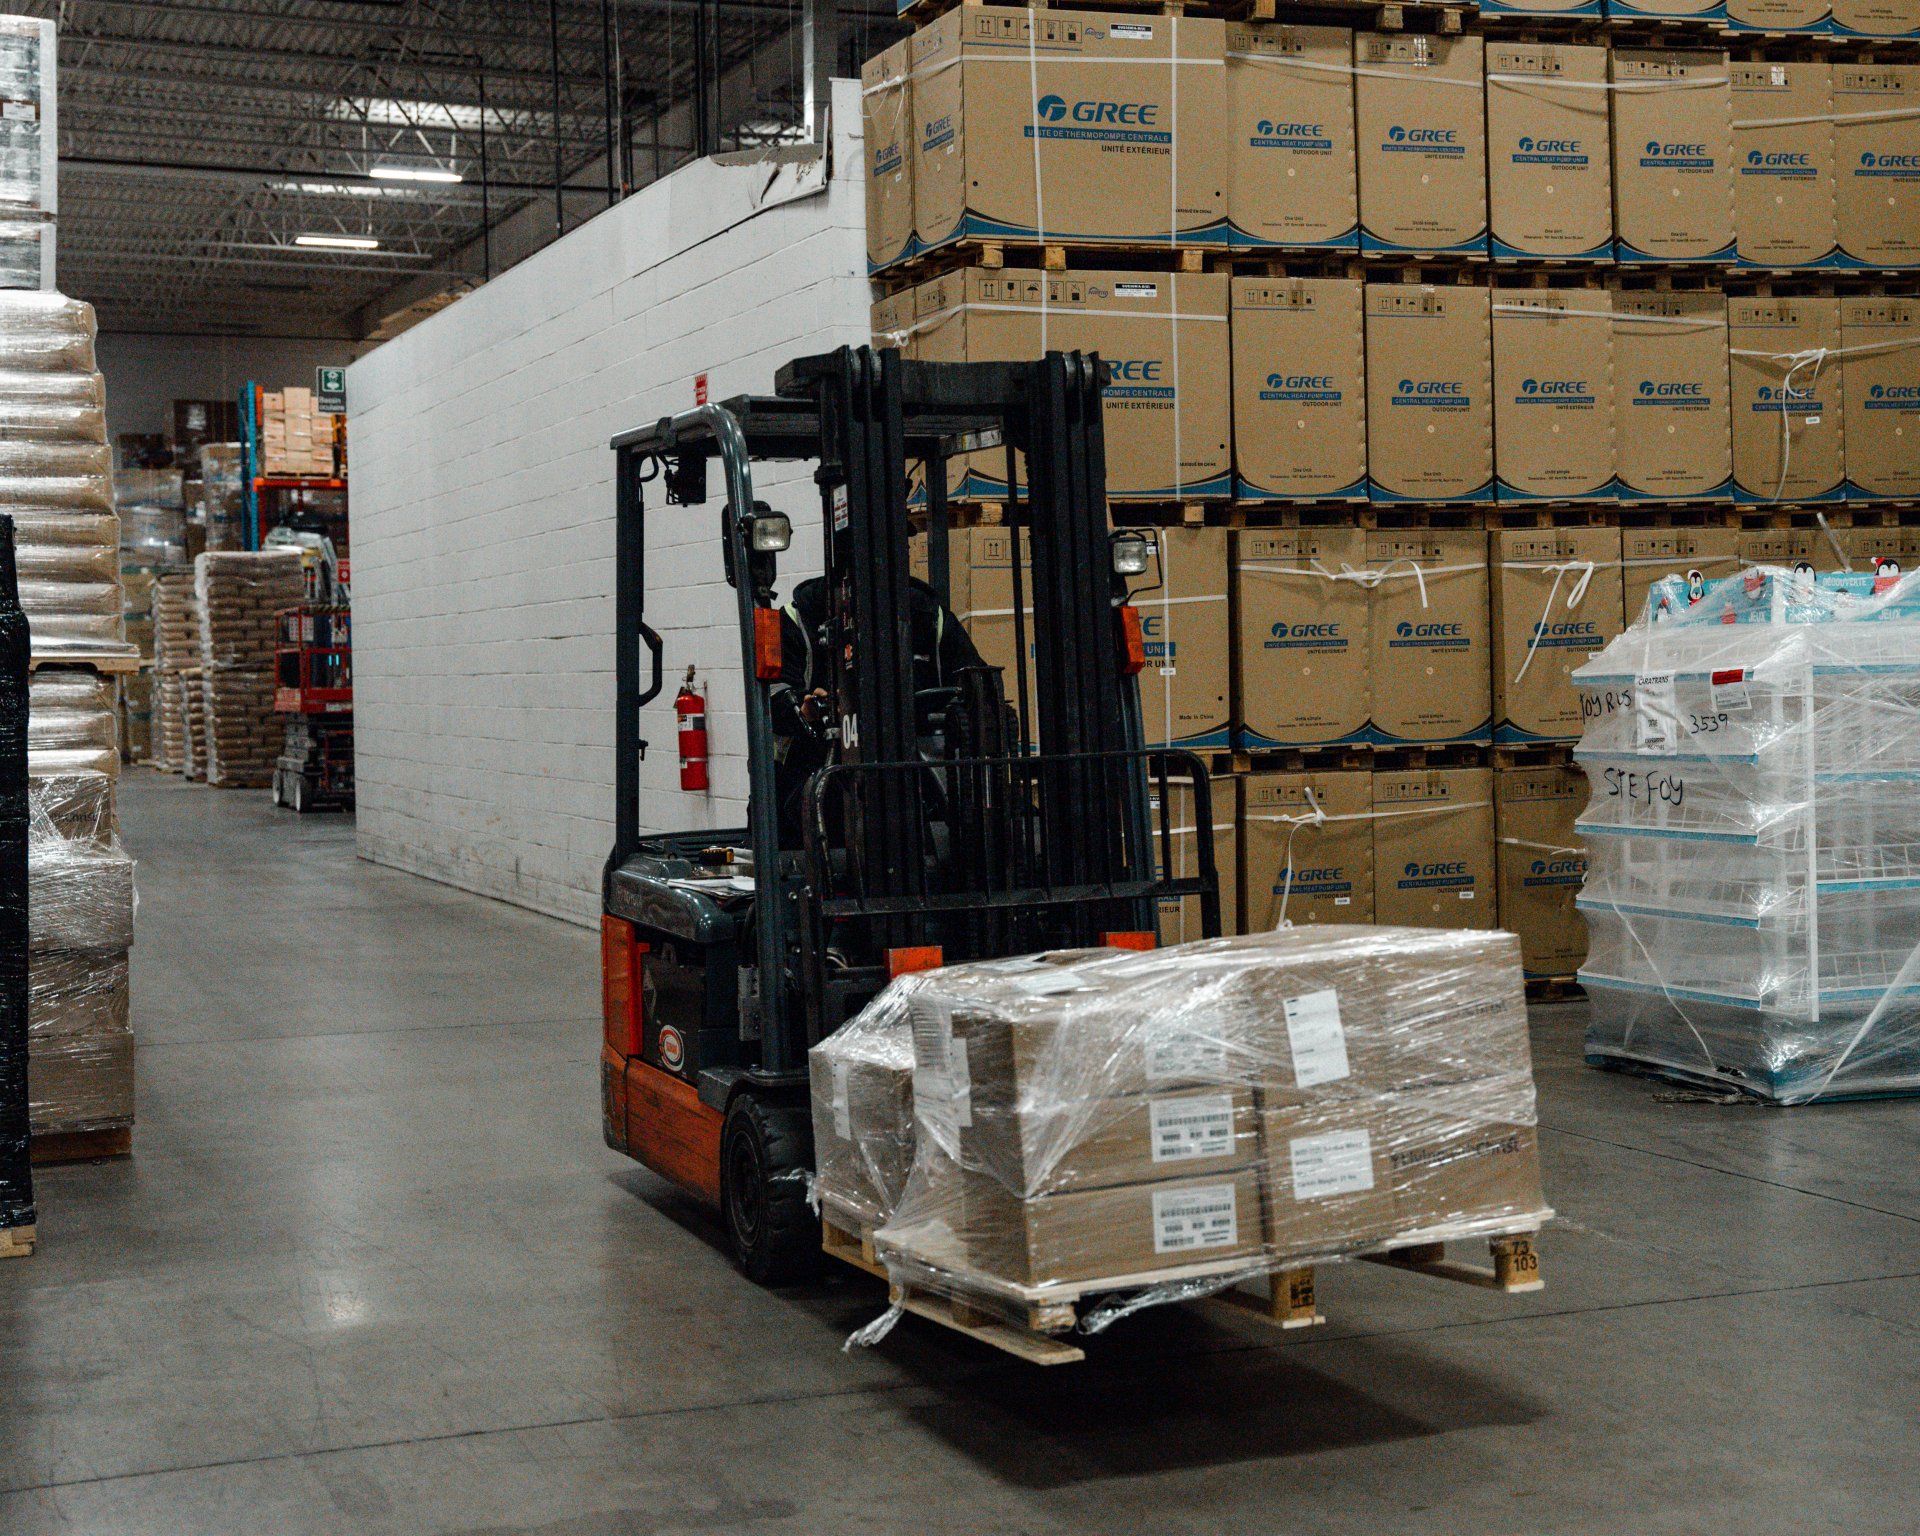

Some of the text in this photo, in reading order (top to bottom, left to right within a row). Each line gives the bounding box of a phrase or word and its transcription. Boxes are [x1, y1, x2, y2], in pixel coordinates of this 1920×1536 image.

[1072, 101, 1159, 125] GREE
[1028, 129, 1169, 142] UITÉ DE THERMOPOMPE CENTRALE
[1276, 123, 1323, 137] GREE
[1408, 128, 1457, 143] GREE
[1101, 144, 1170, 155] UNITÉ EXTÉRIEUR
[1537, 140, 1581, 153] GREE
[1663, 144, 1706, 156] GREE
[1766, 153, 1810, 166] GREE
[1878, 154, 1920, 167] GREE
[1102, 360, 1162, 380] REE
[1285, 376, 1334, 389] GREE
[1417, 381, 1463, 394] GREE
[1540, 381, 1587, 394] GREE
[1132, 389, 1173, 397] CENTRALE
[1657, 383, 1702, 396] GREE
[1106, 401, 1175, 410] UNITÉ EXTÉRIEUR
[1291, 624, 1340, 637] GREE
[1415, 623, 1462, 637] GREE
[1552, 622, 1596, 635] GREE
[1146, 645, 1165, 654] UNI
[1155, 660, 1176, 668] UNT
[1690, 713, 1728, 735] 3539
[842, 713, 859, 750] 04
[1604, 767, 1684, 806] STE FOY
[1423, 862, 1467, 875] GREE
[1549, 860, 1588, 873] GREE
[1298, 867, 1344, 881] GREE
[1512, 1240, 1530, 1256] 73
[1514, 1256, 1538, 1273] 103
